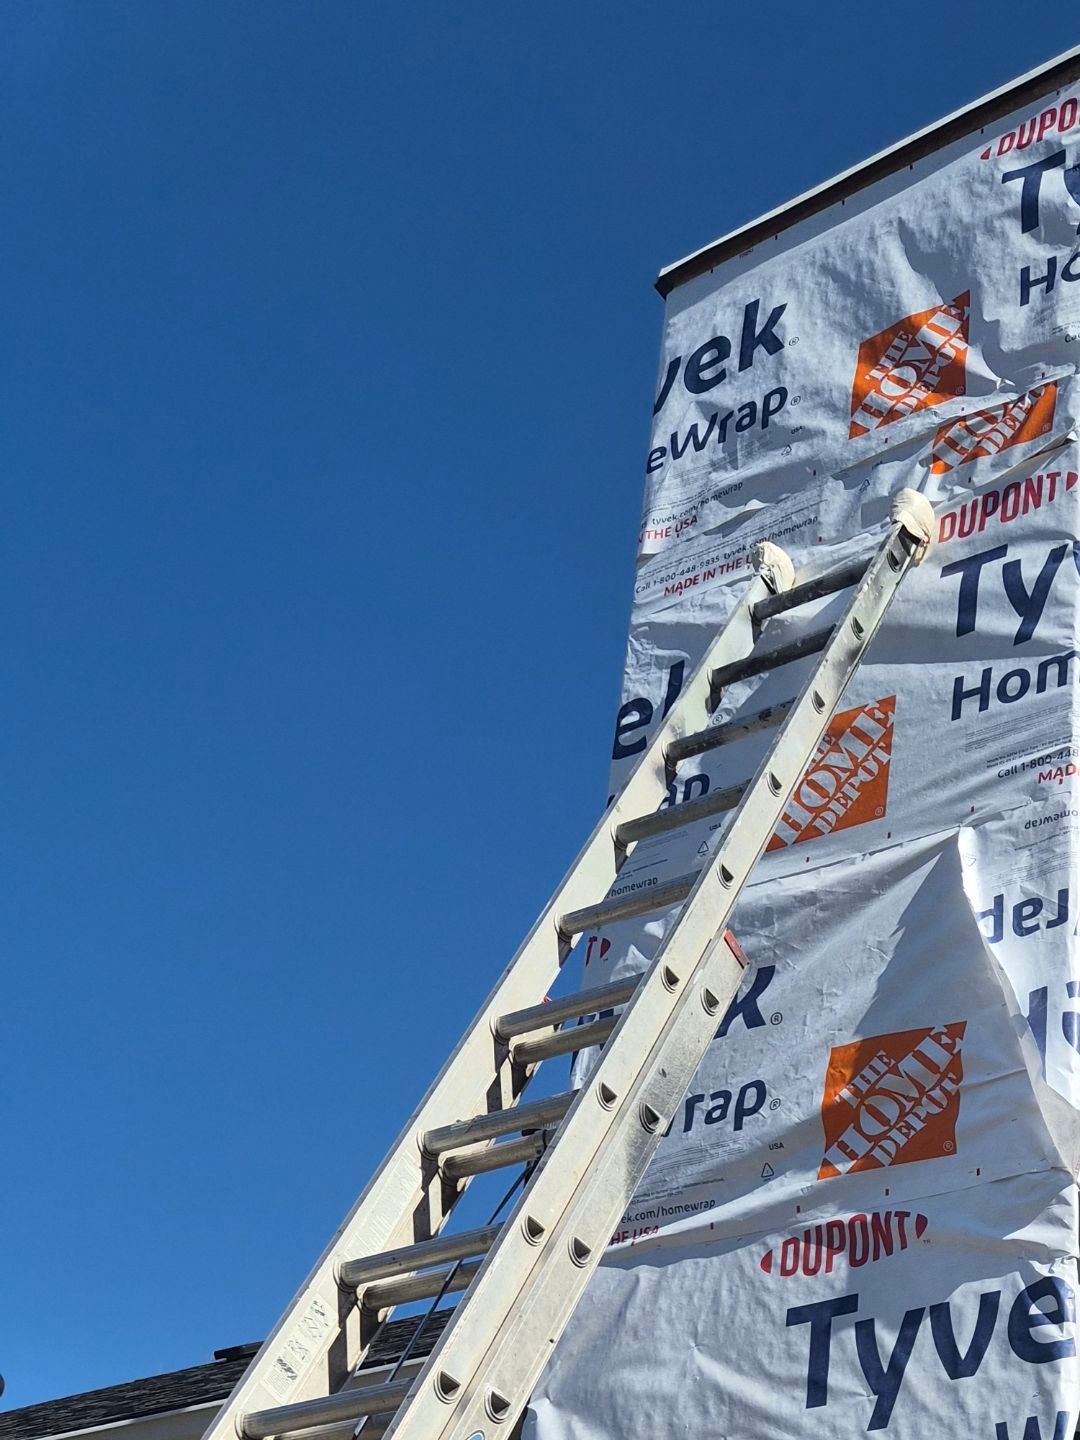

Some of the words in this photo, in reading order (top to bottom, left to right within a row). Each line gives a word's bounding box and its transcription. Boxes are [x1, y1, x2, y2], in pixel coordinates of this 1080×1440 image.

[938, 472, 1062, 543] DUPONT
[664, 573, 700, 597] MADE
[703, 568, 716, 583] IN
[719, 556, 743, 576] THE
[998, 766, 1018, 778] Call
[822, 1024, 966, 1175] HOME
[835, 1049, 895, 1112] THE
[768, 1142, 784, 1151] USA
[871, 1072, 963, 1167] DEPOT
[780, 1211, 910, 1277] DUPONT
